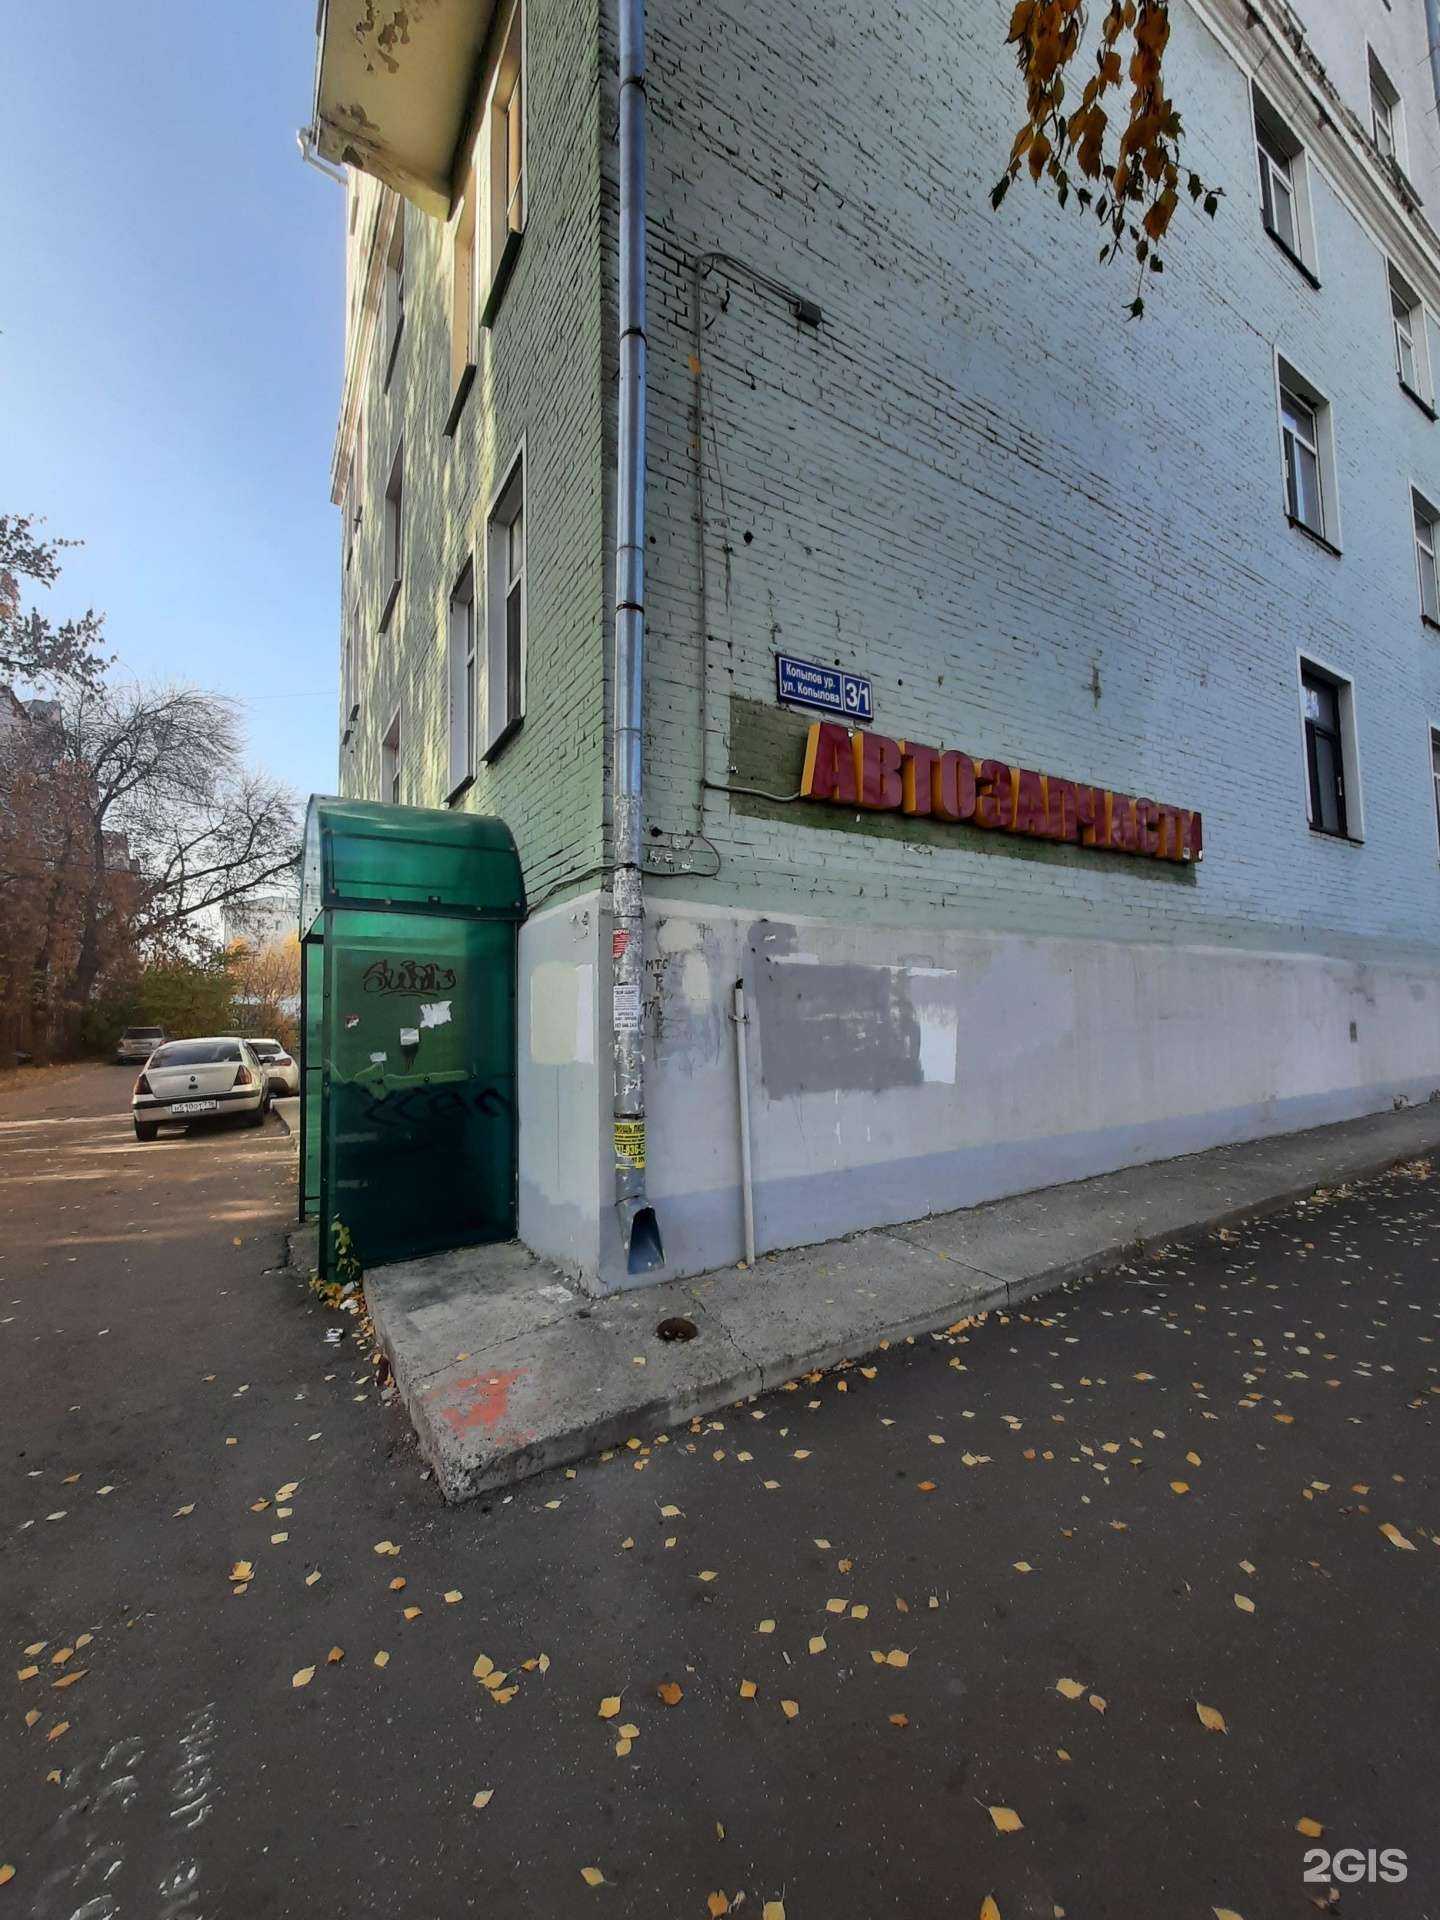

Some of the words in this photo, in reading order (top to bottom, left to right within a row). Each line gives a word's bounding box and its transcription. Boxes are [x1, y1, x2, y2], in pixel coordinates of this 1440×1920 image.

[786, 662, 825, 685] Копылов
[782, 679, 796, 693] ул.
[797, 681, 840, 704] Копылова
[800, 721, 1203, 864] АВТОЗАПЧАСТИ
